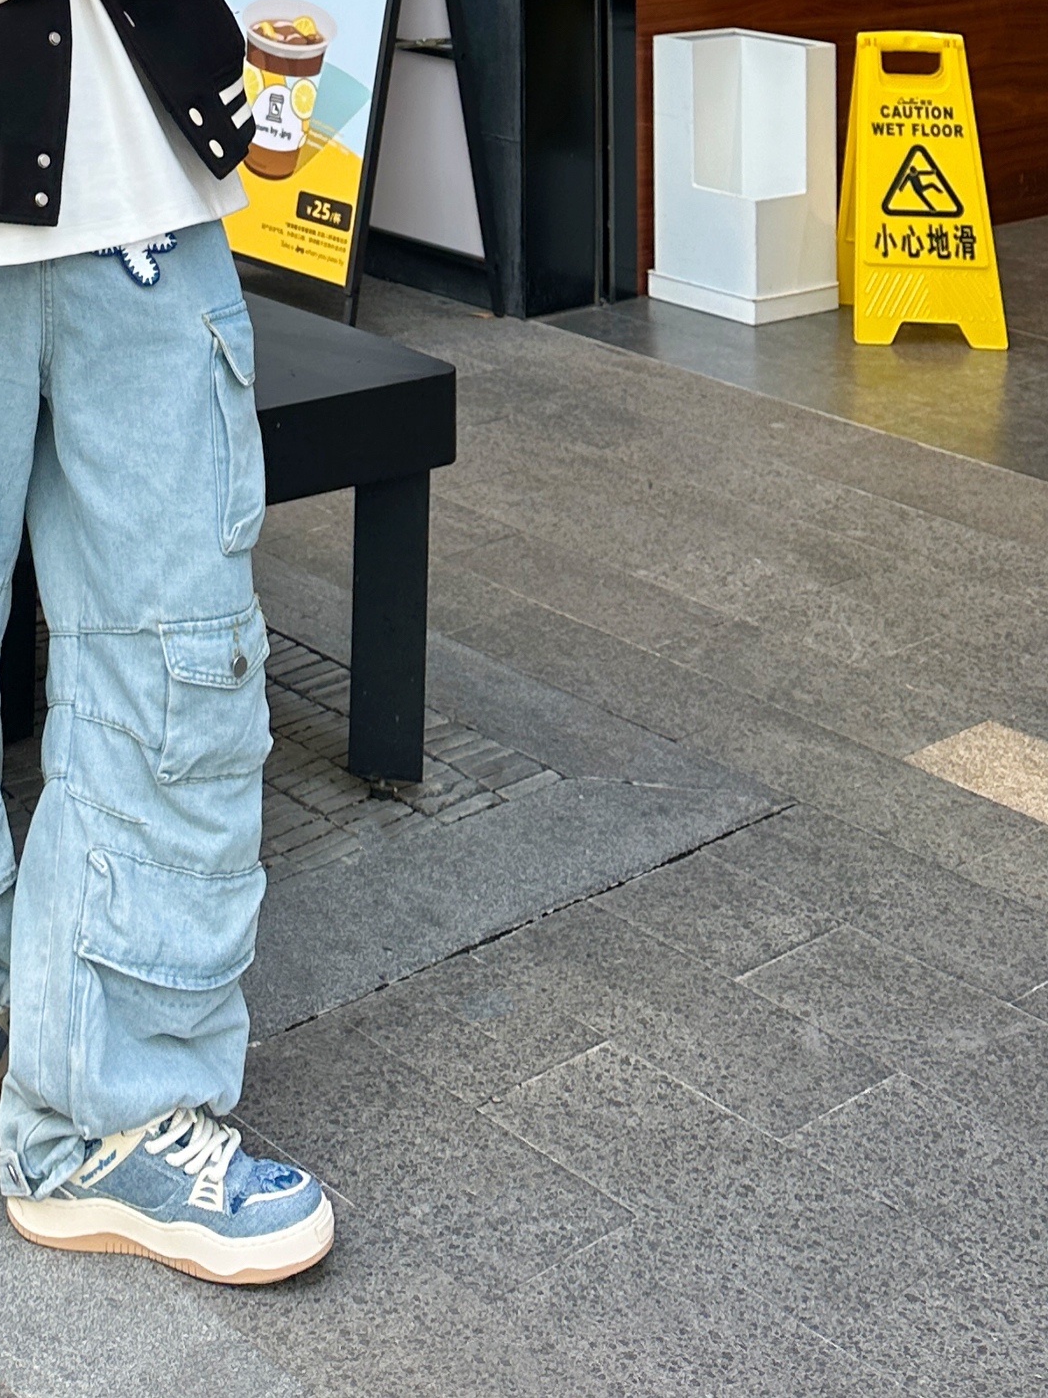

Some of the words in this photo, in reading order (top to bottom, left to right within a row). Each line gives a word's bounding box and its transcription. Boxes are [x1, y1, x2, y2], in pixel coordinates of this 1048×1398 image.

[880, 104, 954, 120] CAUTION
[871, 122, 905, 137] WET
[911, 123, 964, 138] FLOOR
[874, 222, 977, 261] 小心地滑
